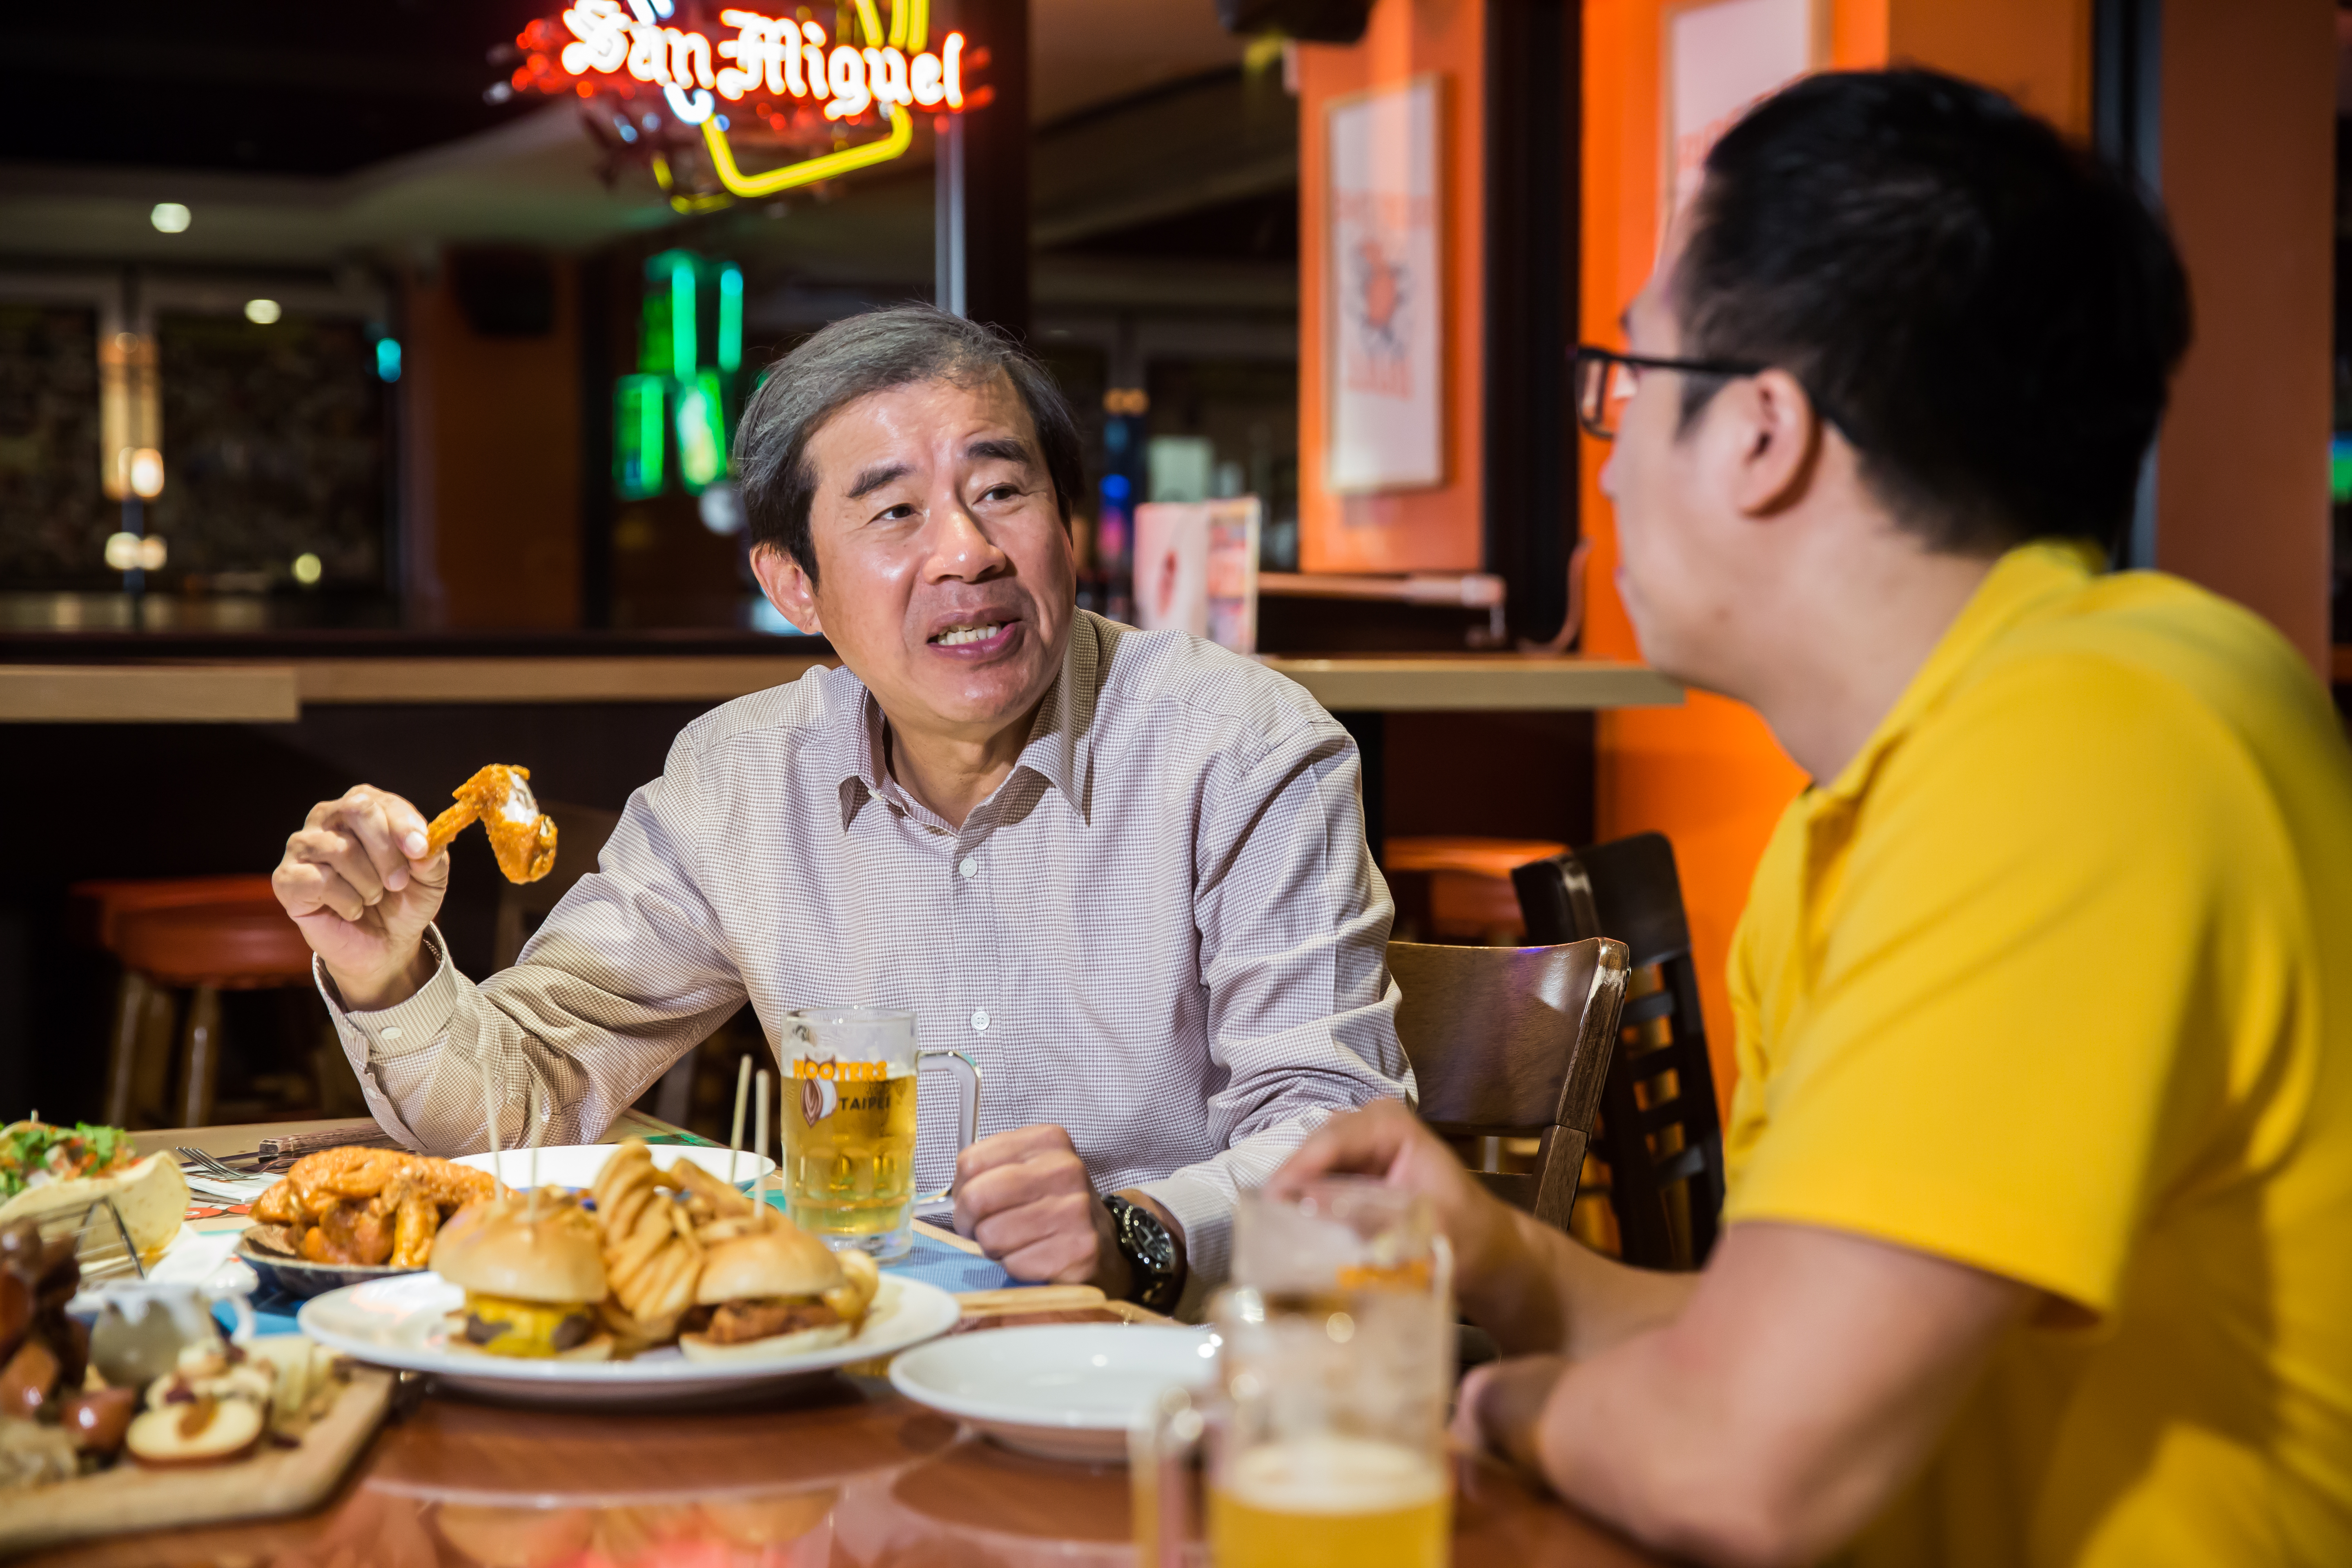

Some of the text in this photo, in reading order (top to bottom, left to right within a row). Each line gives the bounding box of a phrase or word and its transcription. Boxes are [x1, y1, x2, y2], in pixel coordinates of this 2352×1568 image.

[561, 0, 964, 120] San Miguel
[793, 1059, 887, 1081] HOOTERS
